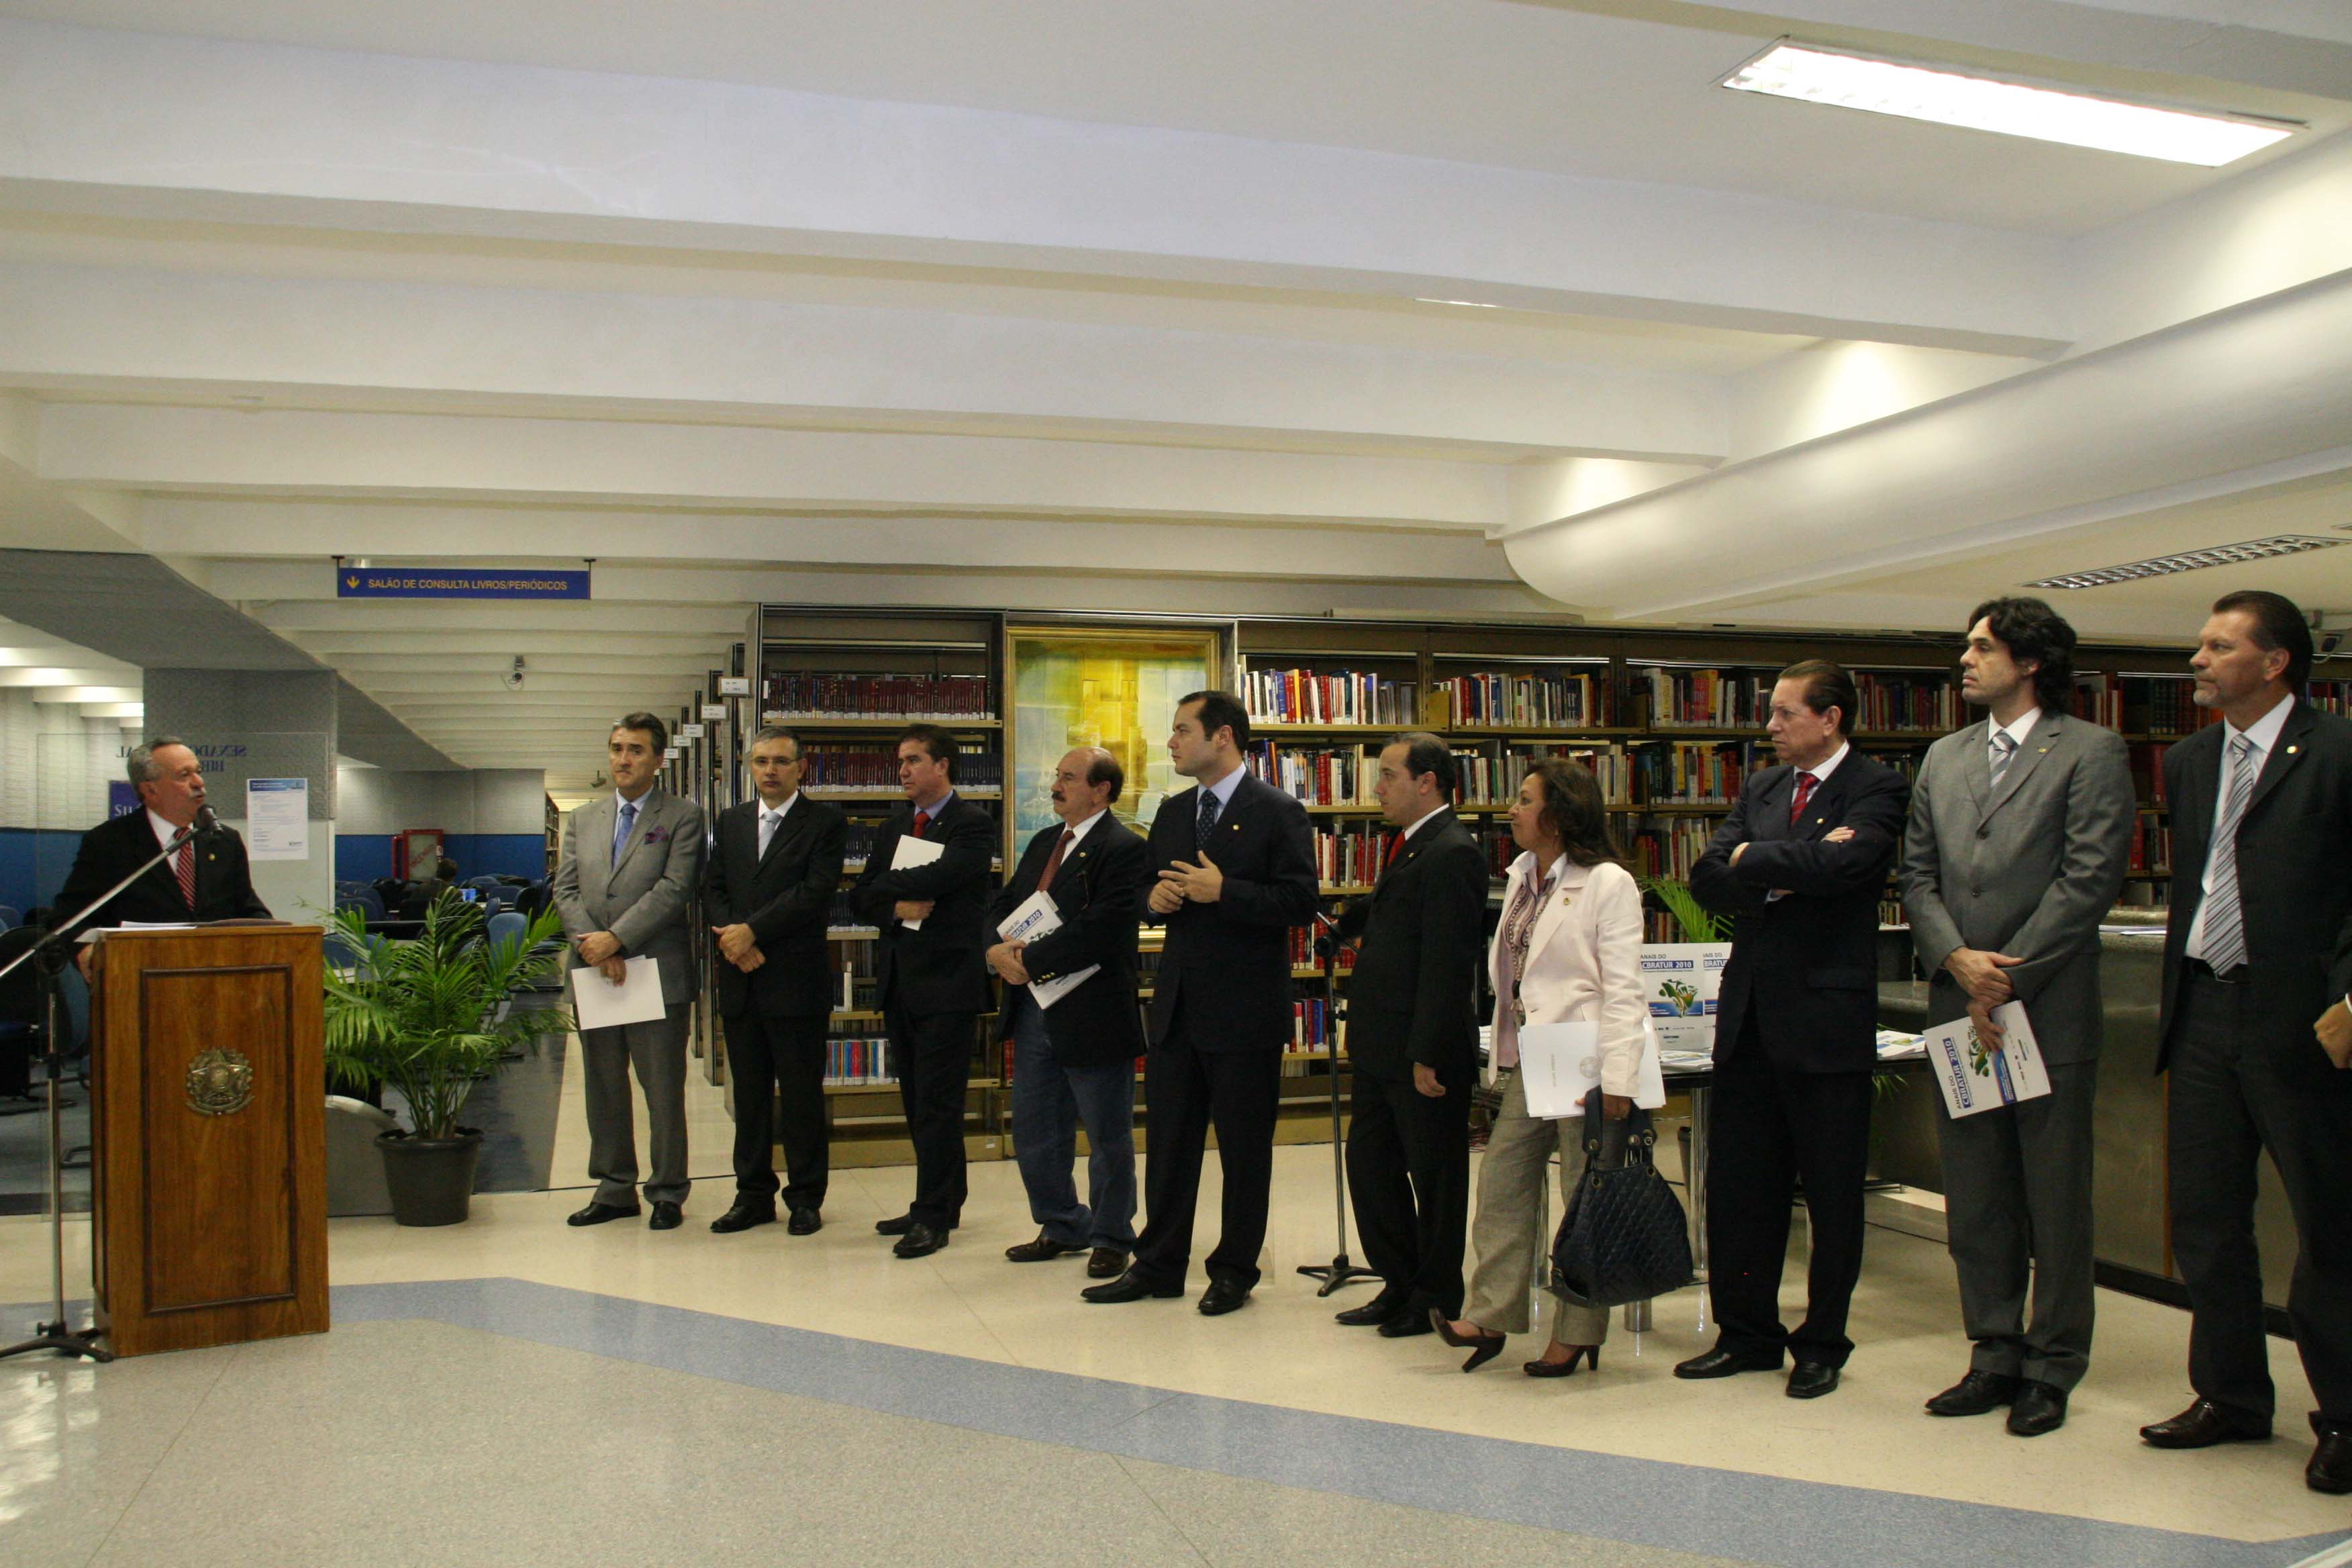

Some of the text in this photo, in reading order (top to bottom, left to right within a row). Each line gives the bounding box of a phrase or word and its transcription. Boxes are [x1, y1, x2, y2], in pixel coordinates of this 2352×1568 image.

[368, 577, 568, 591] SALÃO DE CONSULTA LIVROS/PERIÓDICOS
[1642, 961, 1692, 969] CBRATUR 2010
[1945, 1040, 1957, 1062] 2010
[1953, 1064, 1969, 1105] CBRATUR
